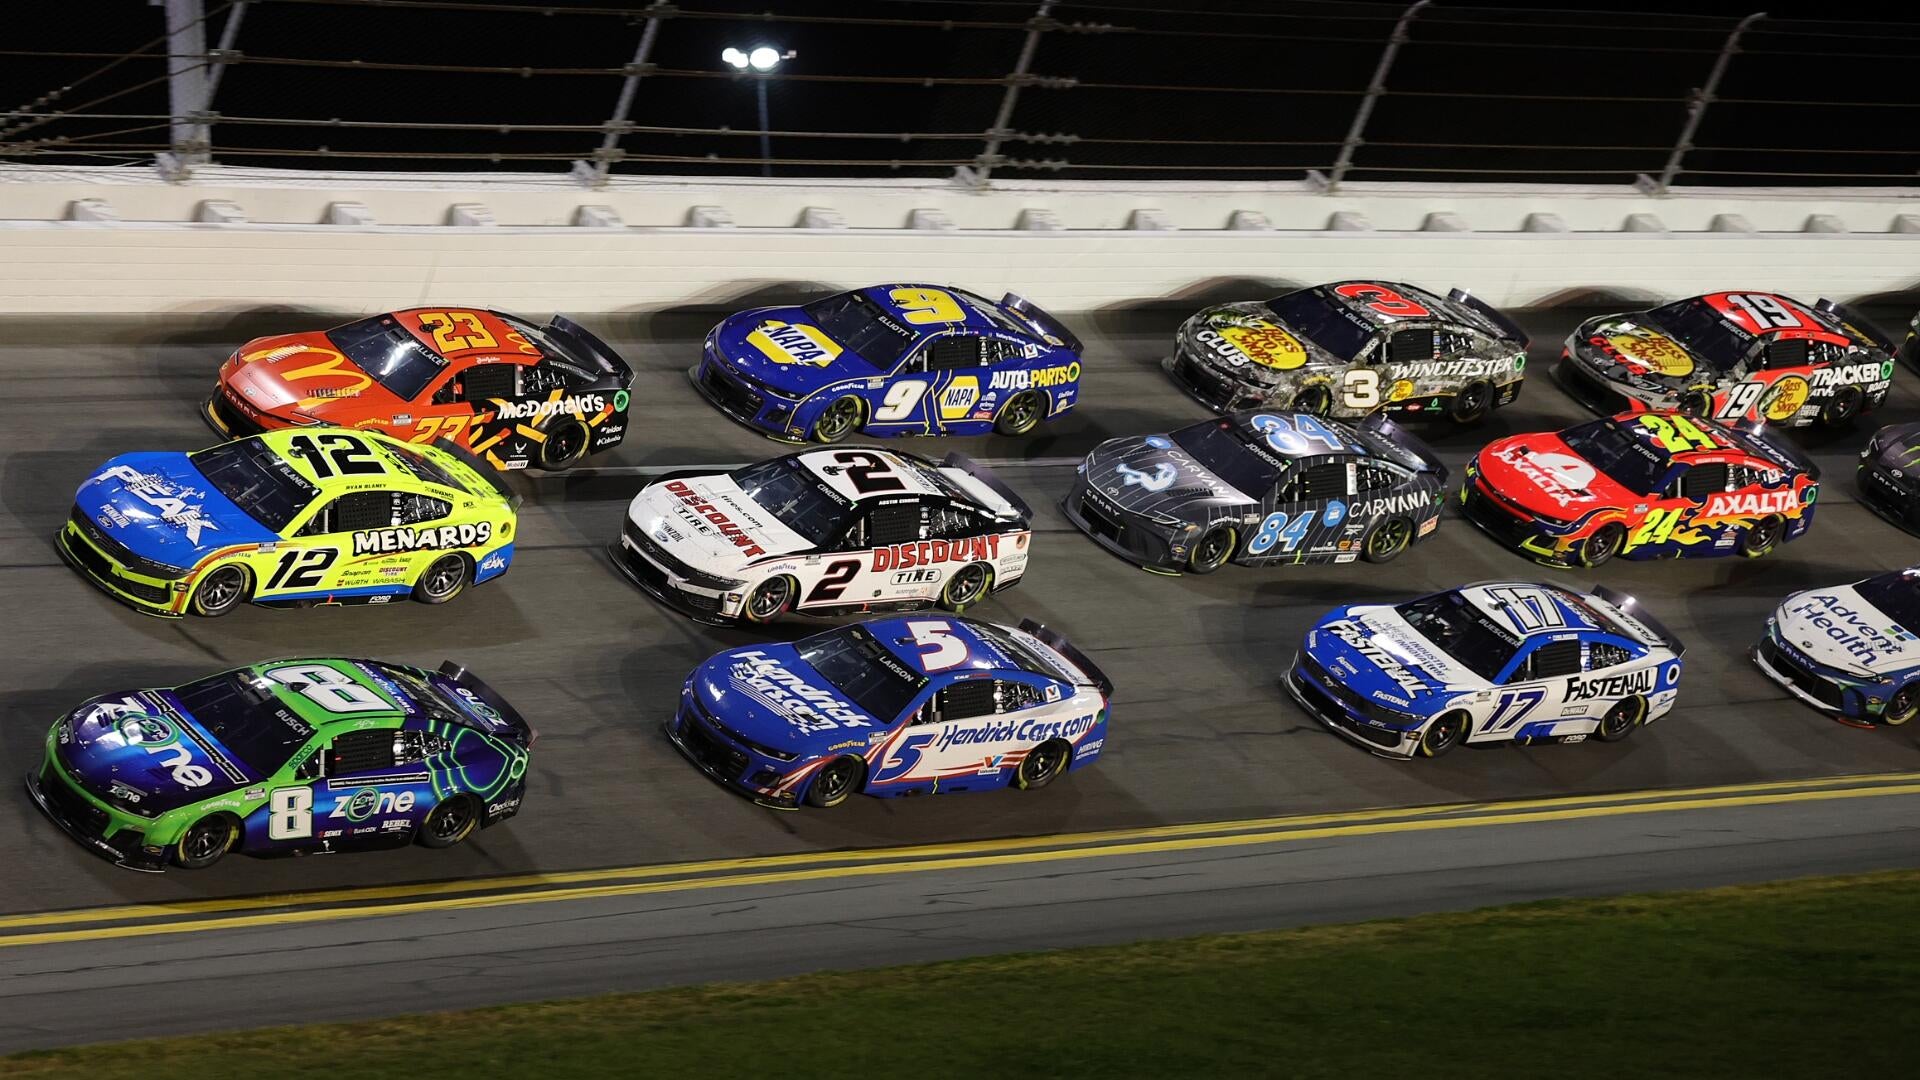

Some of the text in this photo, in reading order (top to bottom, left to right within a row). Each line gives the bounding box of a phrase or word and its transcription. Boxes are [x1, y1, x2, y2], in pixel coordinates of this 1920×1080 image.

[889, 288, 967, 325] 9
[1335, 284, 1430, 317] 3
[1727, 294, 1803, 330] 19
[417, 312, 499, 354] 23
[878, 315, 910, 337] ELLIOTT
[1345, 313, 1374, 334] DILLON
[768, 325, 826, 362] NAPA
[1197, 330, 1250, 367] CLUB
[988, 367, 1068, 390] AUTO PARTS
[1390, 356, 1513, 379] WINCHESTER
[1811, 362, 1882, 388] TRACKER
[831, 383, 866, 393] GOODYEAR
[875, 381, 928, 421] 9
[944, 388, 975, 407] NAPA
[1342, 369, 1380, 409] 3
[1716, 384, 1765, 419] 19
[1778, 391, 1793, 401] Pro
[1781, 380, 1802, 392] Bass
[1867, 379, 1891, 393] BOATS
[225, 391, 258, 418] CAMRY
[497, 394, 605, 420] McDonald's
[1773, 400, 1798, 414] Shops
[1250, 413, 1345, 455] 84
[1639, 415, 1719, 453] 24
[287, 434, 387, 479] 12
[1245, 443, 1285, 472] JOHNSON
[1632, 443, 1661, 463] BYRON
[278, 466, 313, 492] BLANEY
[833, 452, 907, 494] 2
[817, 483, 847, 506] CINDRIC
[950, 500, 974, 512] Snap-on
[1086, 488, 1121, 518] CAMRY
[1348, 490, 1431, 519] CARVANA
[1706, 489, 1798, 518] AXALTA
[664, 481, 767, 558] DISCOUNT
[678, 507, 708, 534] TIRE
[721, 494, 763, 529] tires.com
[1630, 507, 1685, 546] 24
[352, 521, 492, 557] MENARDS
[1248, 509, 1317, 555] 84
[264, 548, 340, 591] 12
[479, 557, 505, 574] PEAK
[870, 534, 1000, 573] DISCOUNT
[804, 558, 862, 603] 2
[896, 571, 936, 583] TIRE
[1484, 586, 1567, 629] 17
[1478, 617, 1522, 649] BUESCHER
[1791, 602, 1878, 668] Health
[1811, 594, 1903, 656] Advent
[906, 620, 969, 671] 5
[1409, 640, 1449, 672] INDUSTRY
[1779, 640, 1817, 669] CAMRY
[879, 655, 914, 683] LARSON
[263, 664, 399, 713] 8
[730, 650, 872, 728] Hendrick
[1373, 690, 1410, 708] FASTENAL
[1561, 670, 1651, 703] FASTENAL
[274, 708, 310, 736] BUSCH
[1478, 690, 1547, 735] 17
[828, 740, 866, 751] GOODYEAR
[936, 713, 1094, 752] HendrickCars.com
[870, 732, 940, 784] 5
[269, 785, 313, 841] 8
[381, 819, 412, 829] REBEL
